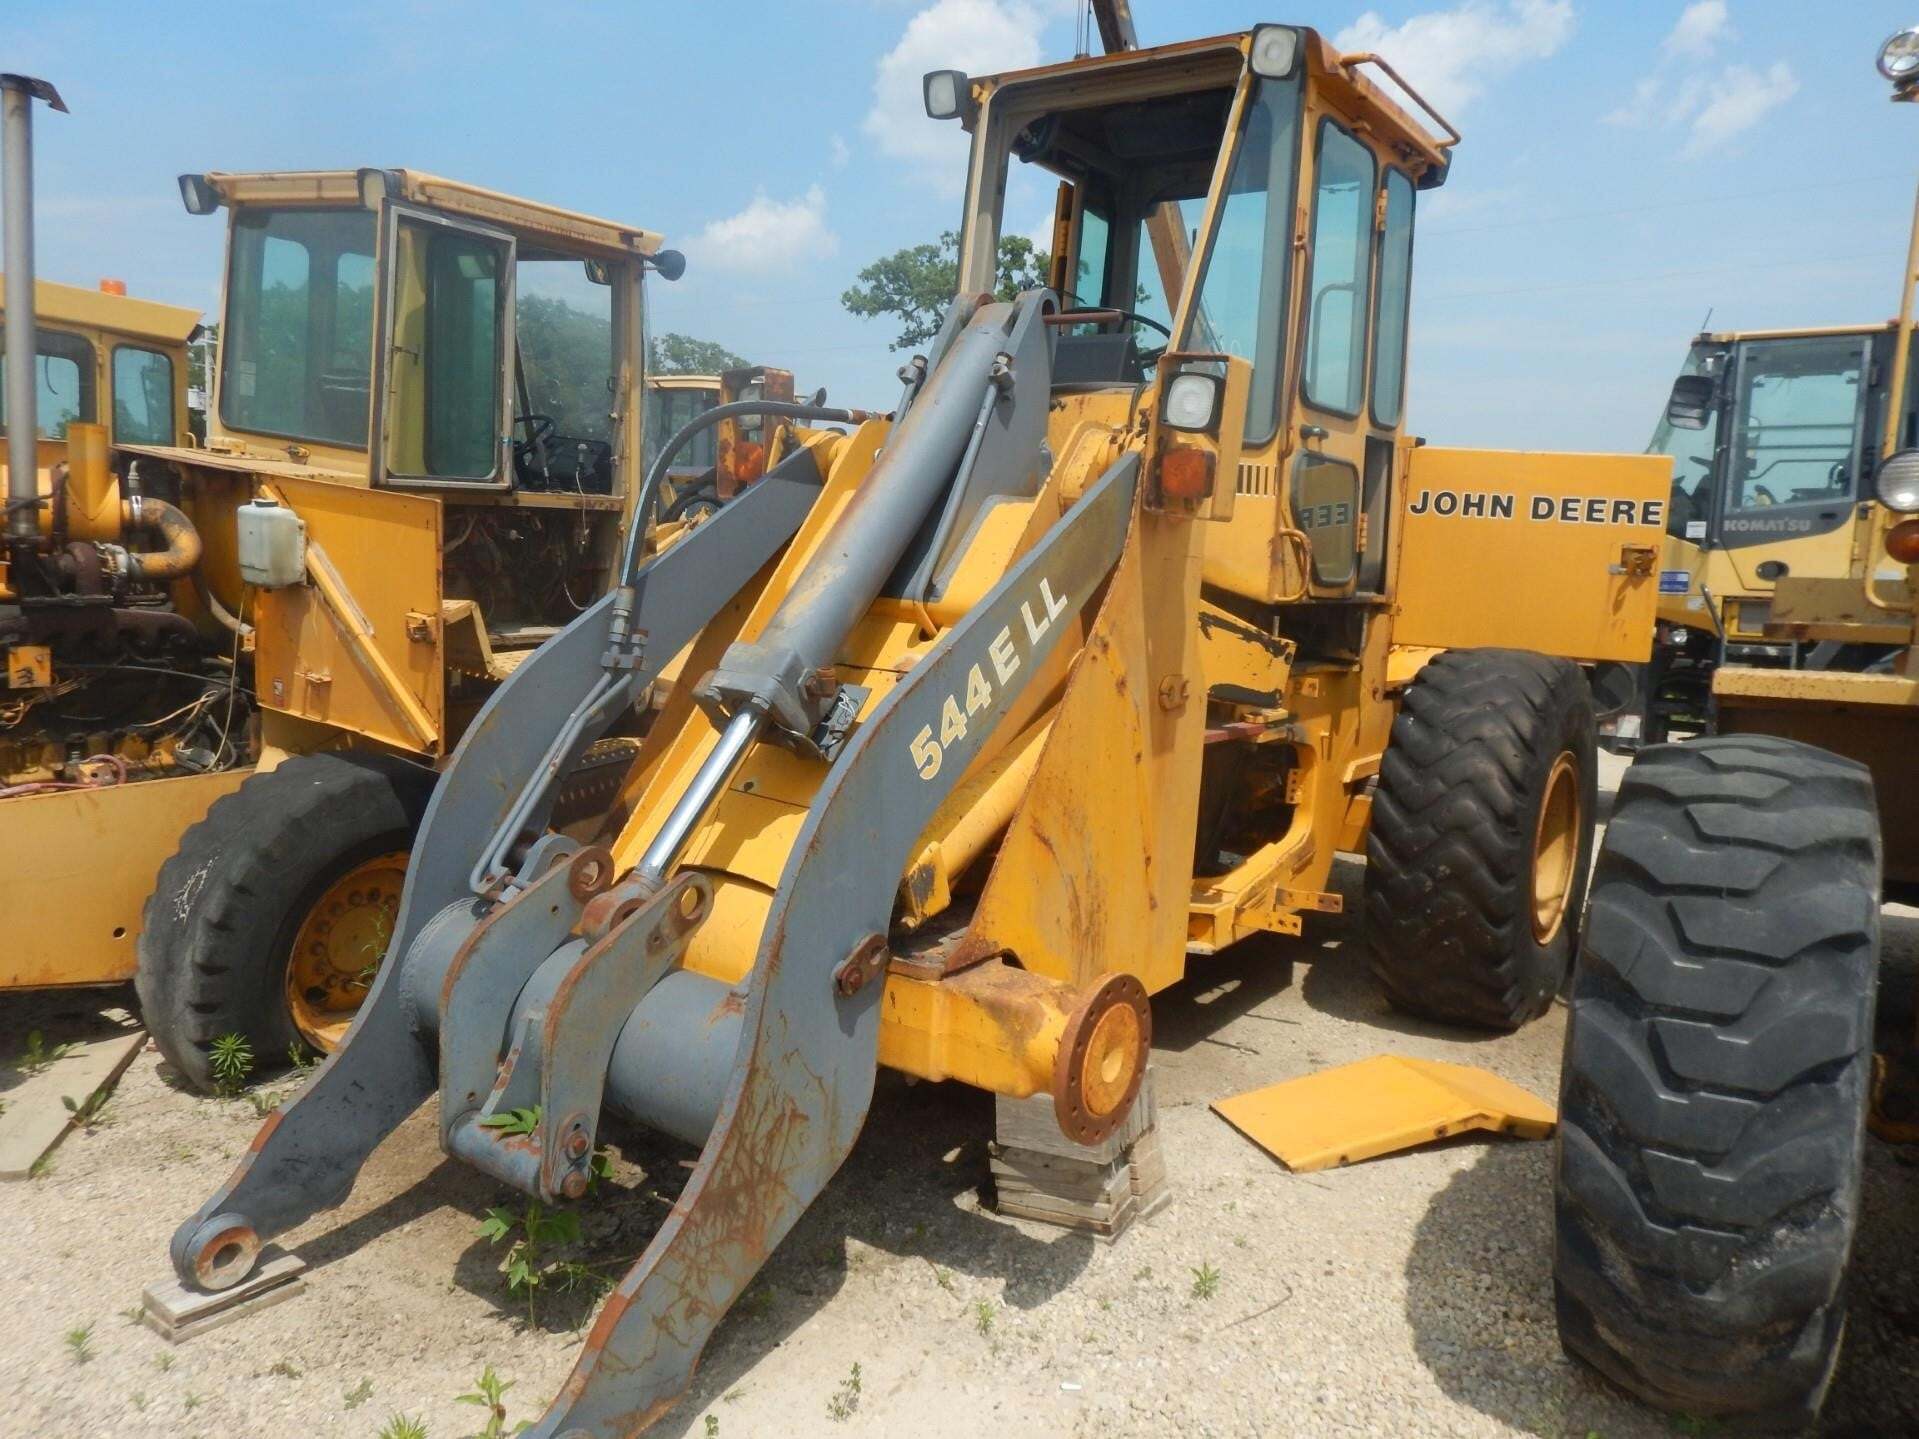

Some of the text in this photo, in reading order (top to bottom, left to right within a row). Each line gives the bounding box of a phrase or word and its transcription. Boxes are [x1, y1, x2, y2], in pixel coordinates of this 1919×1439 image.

[1409, 490, 1665, 526] JOHN DEERE
[1723, 516, 1811, 532] KOMATSU
[1020, 577, 1068, 645] LL
